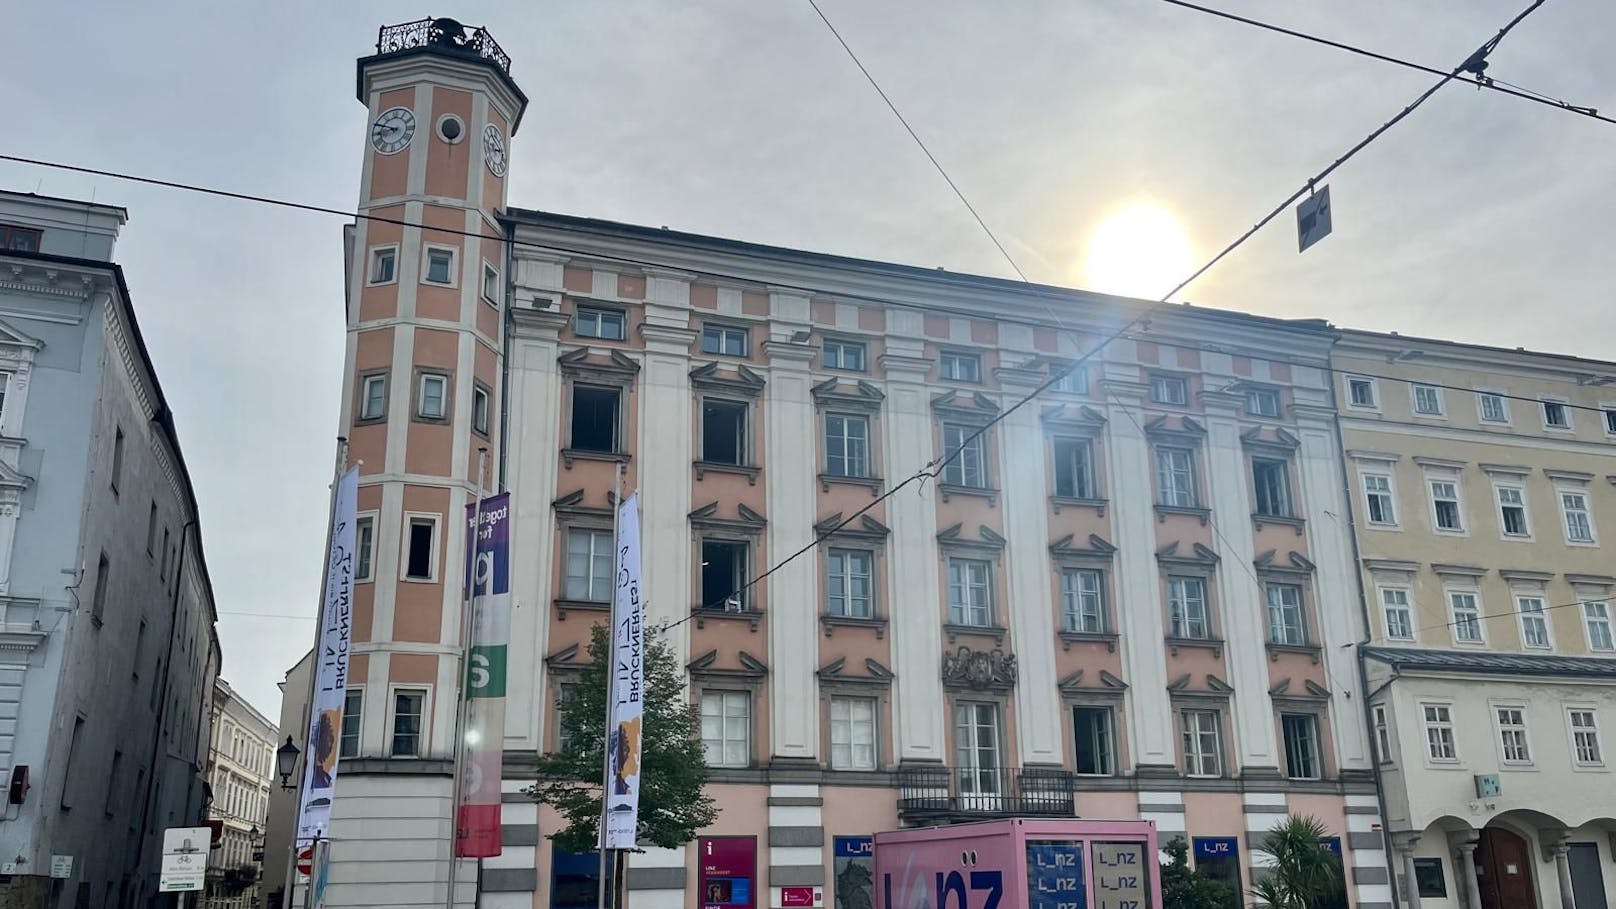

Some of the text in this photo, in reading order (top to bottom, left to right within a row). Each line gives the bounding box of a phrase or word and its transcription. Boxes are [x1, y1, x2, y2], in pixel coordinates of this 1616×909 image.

[1204, 841, 1229, 854] L_nz
[1037, 852, 1076, 868] L_nz
[1099, 851, 1137, 867] L_nz
[1038, 877, 1077, 893] L_nz
[1100, 875, 1138, 891] L_nz
